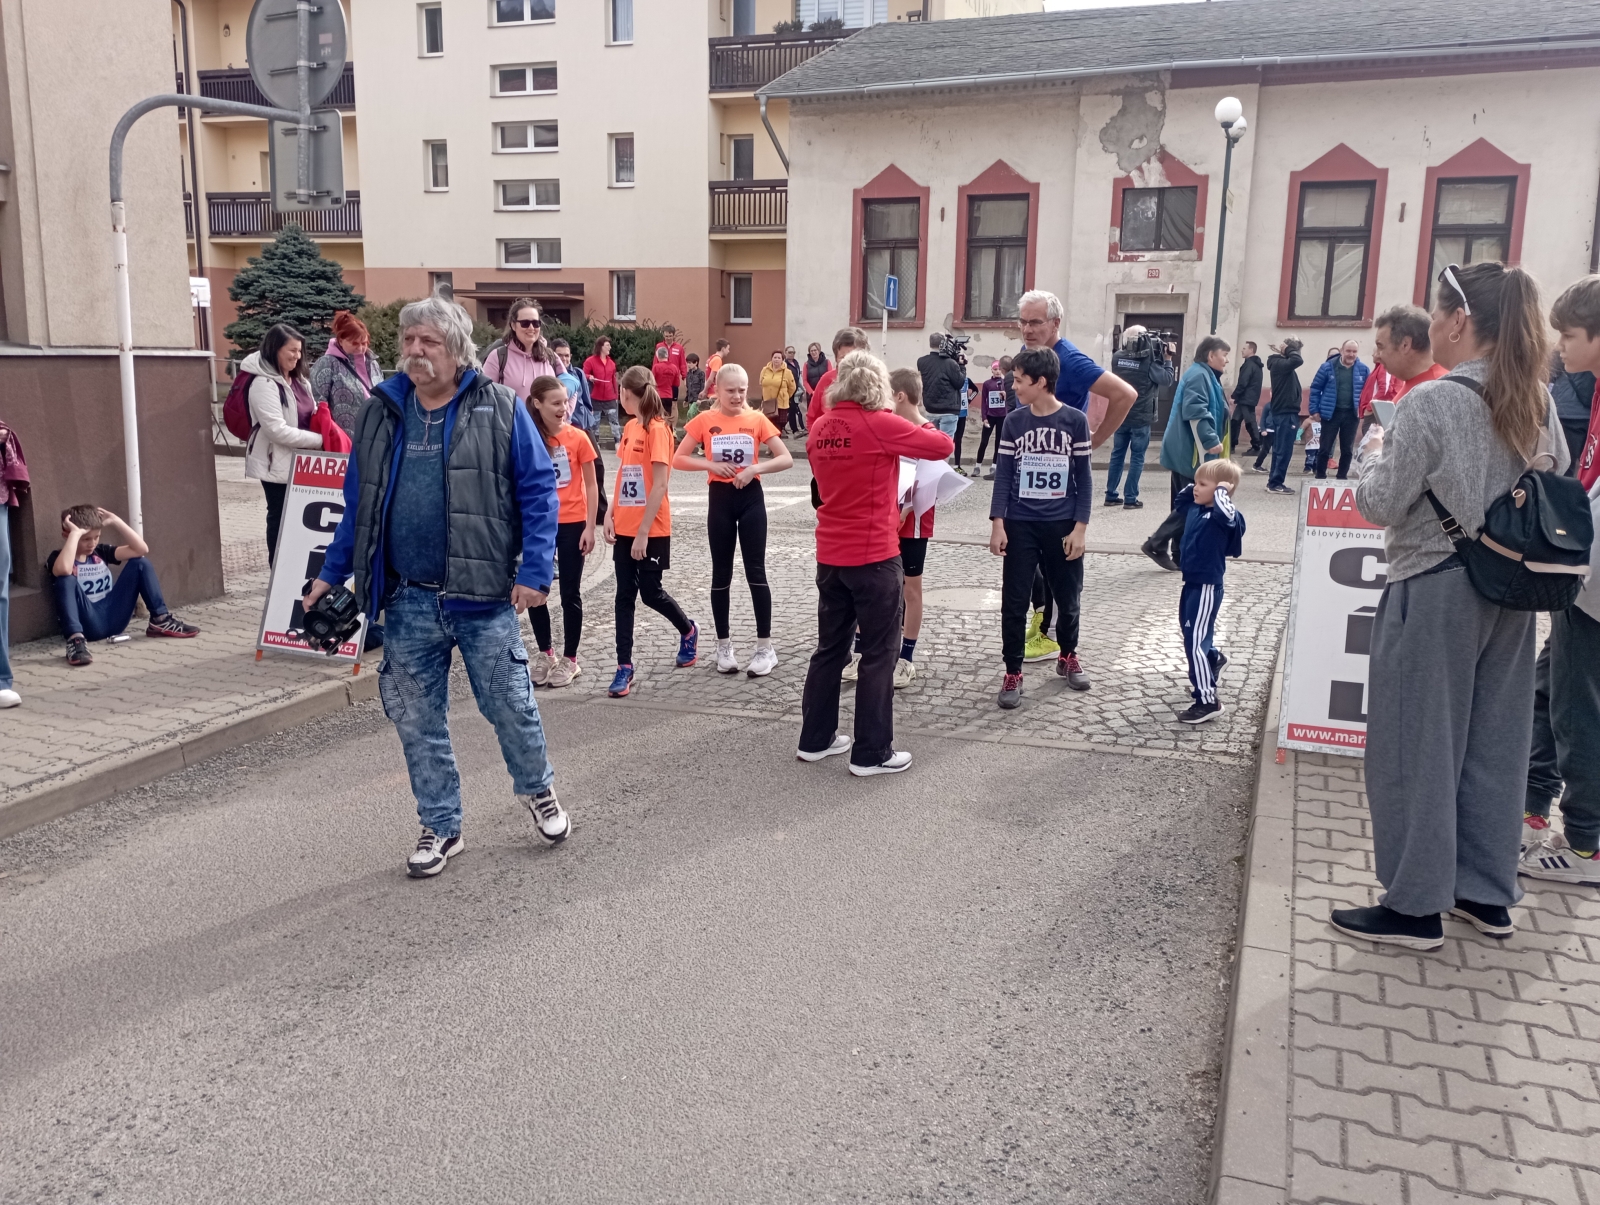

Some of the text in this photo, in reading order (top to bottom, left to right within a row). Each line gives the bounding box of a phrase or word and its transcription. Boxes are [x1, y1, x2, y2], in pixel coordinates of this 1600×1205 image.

[294, 455, 348, 477] MARA
[722, 448, 745, 464] 58
[621, 481, 638, 498] 43
[1026, 470, 1062, 490] 158
[1307, 486, 1358, 511] MA
[1306, 529, 1382, 541] tělovýchovná
[83, 574, 111, 596] 222
